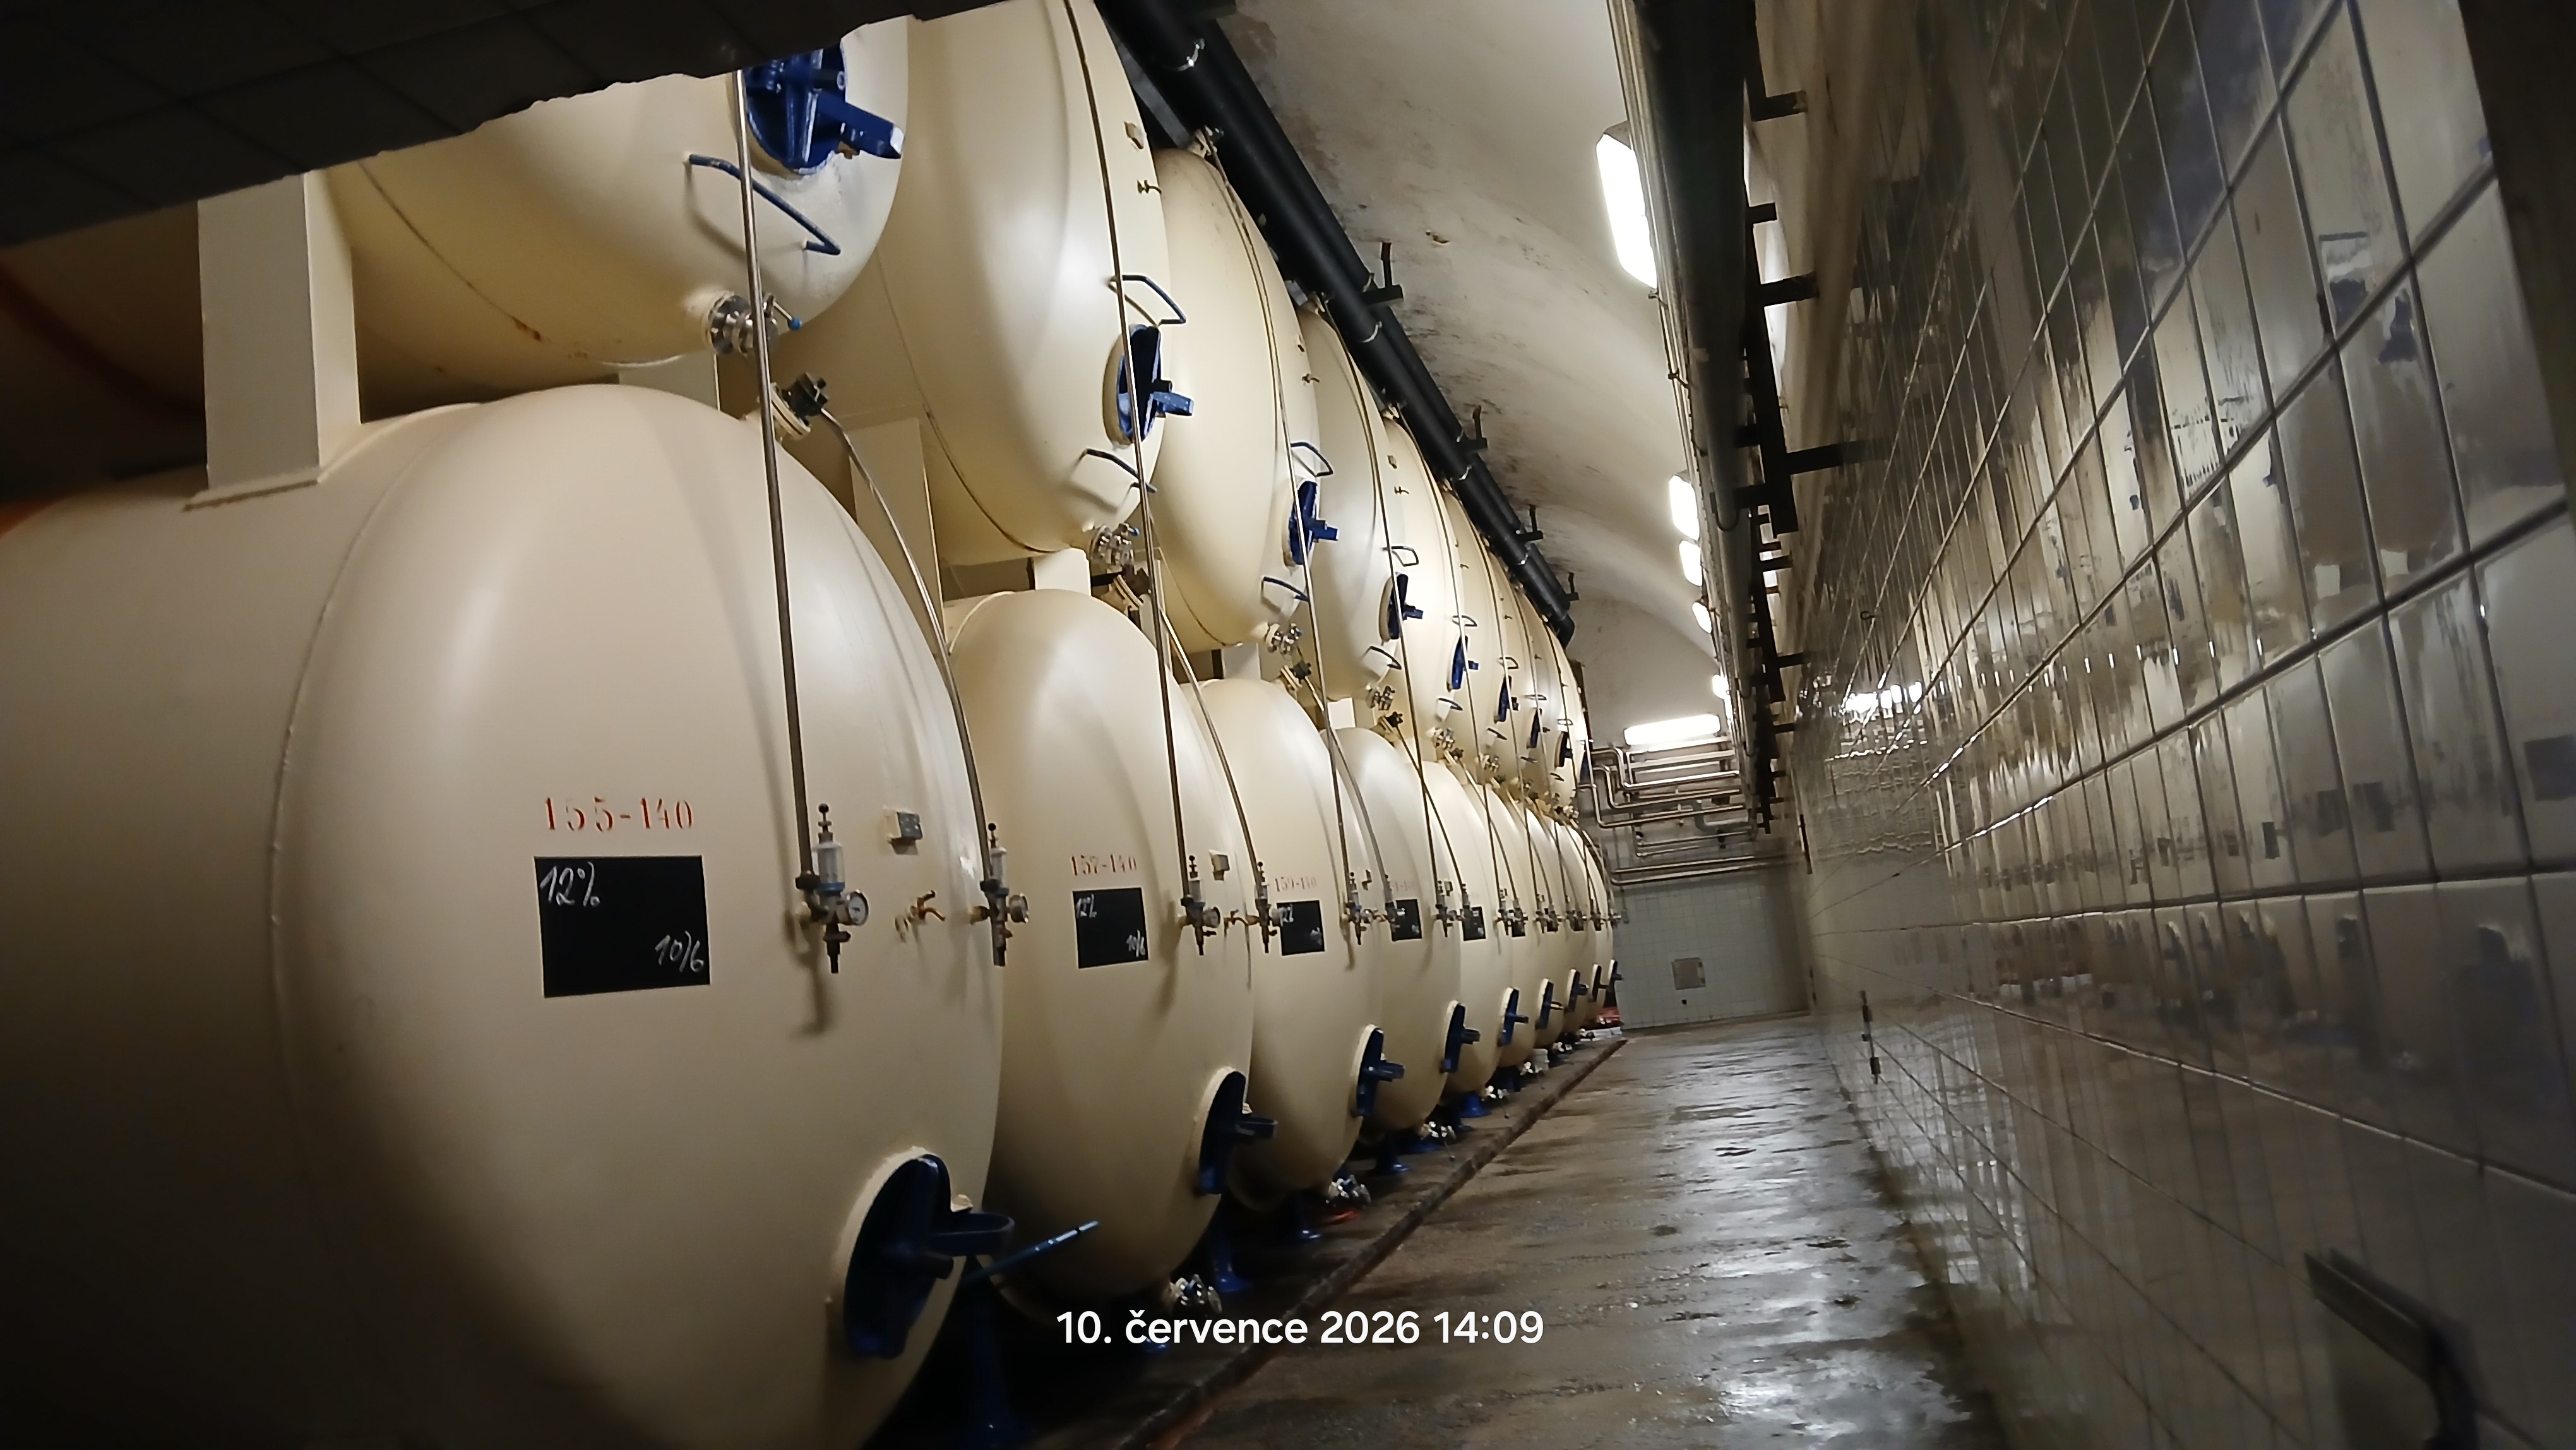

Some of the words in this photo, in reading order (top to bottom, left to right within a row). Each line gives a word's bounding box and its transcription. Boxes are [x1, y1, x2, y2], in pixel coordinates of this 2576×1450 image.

[545, 796, 693, 832] 155-140
[540, 861, 600, 908] 12%
[654, 930, 704, 973] 10/6
